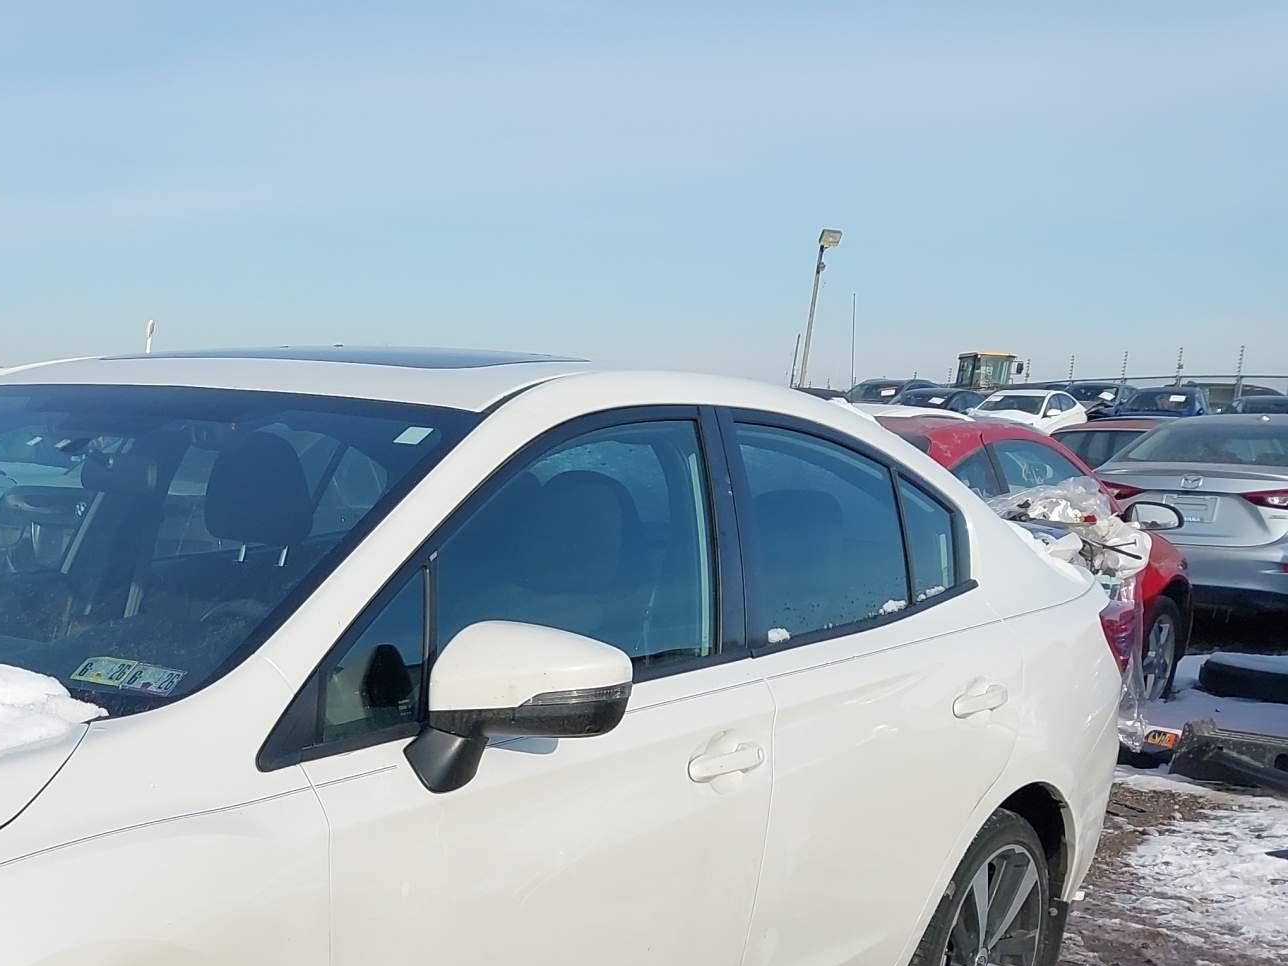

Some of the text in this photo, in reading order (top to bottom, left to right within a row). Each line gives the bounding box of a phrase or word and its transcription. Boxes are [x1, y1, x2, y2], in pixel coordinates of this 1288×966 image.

[78, 662, 93, 677] 6
[126, 670, 180, 690] 6 26
